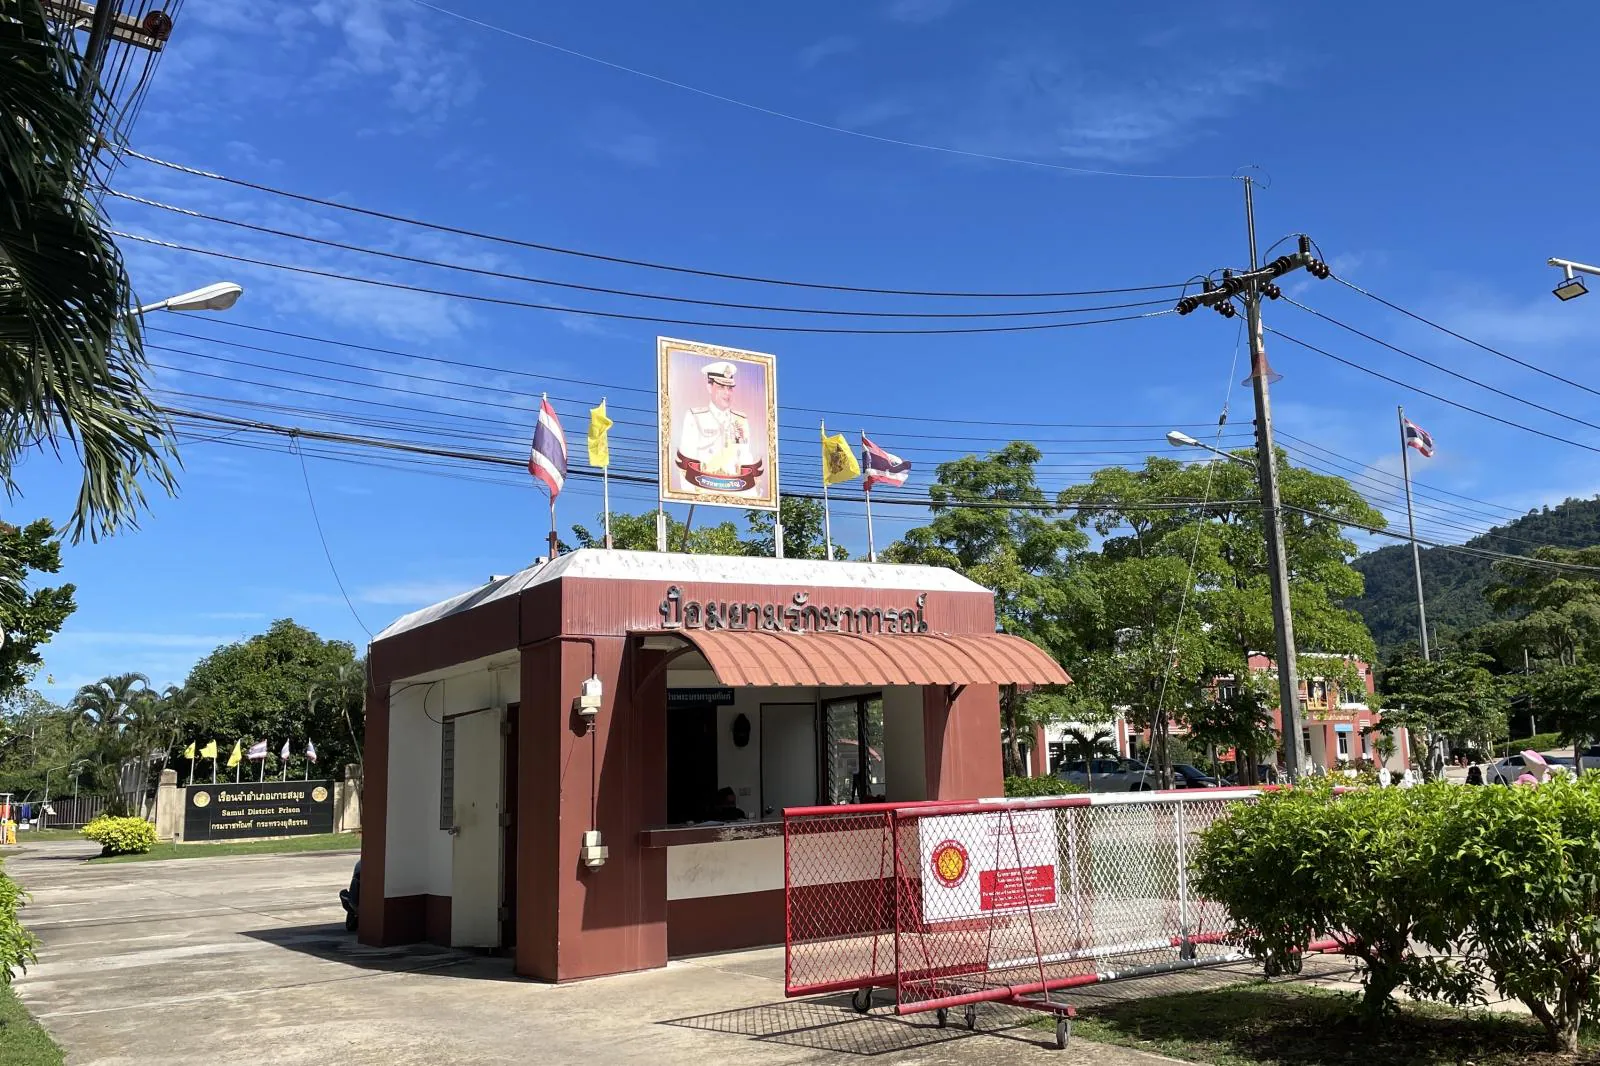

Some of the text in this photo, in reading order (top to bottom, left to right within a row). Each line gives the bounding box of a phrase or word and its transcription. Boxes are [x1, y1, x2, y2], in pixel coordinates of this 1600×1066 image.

[659, 585, 928, 633] ป้อมยามรักษาการณ์
[218, 790, 305, 802] เรือนจำอำเภอเกาะสมุย
[221, 806, 301, 817] Samui District Prison
